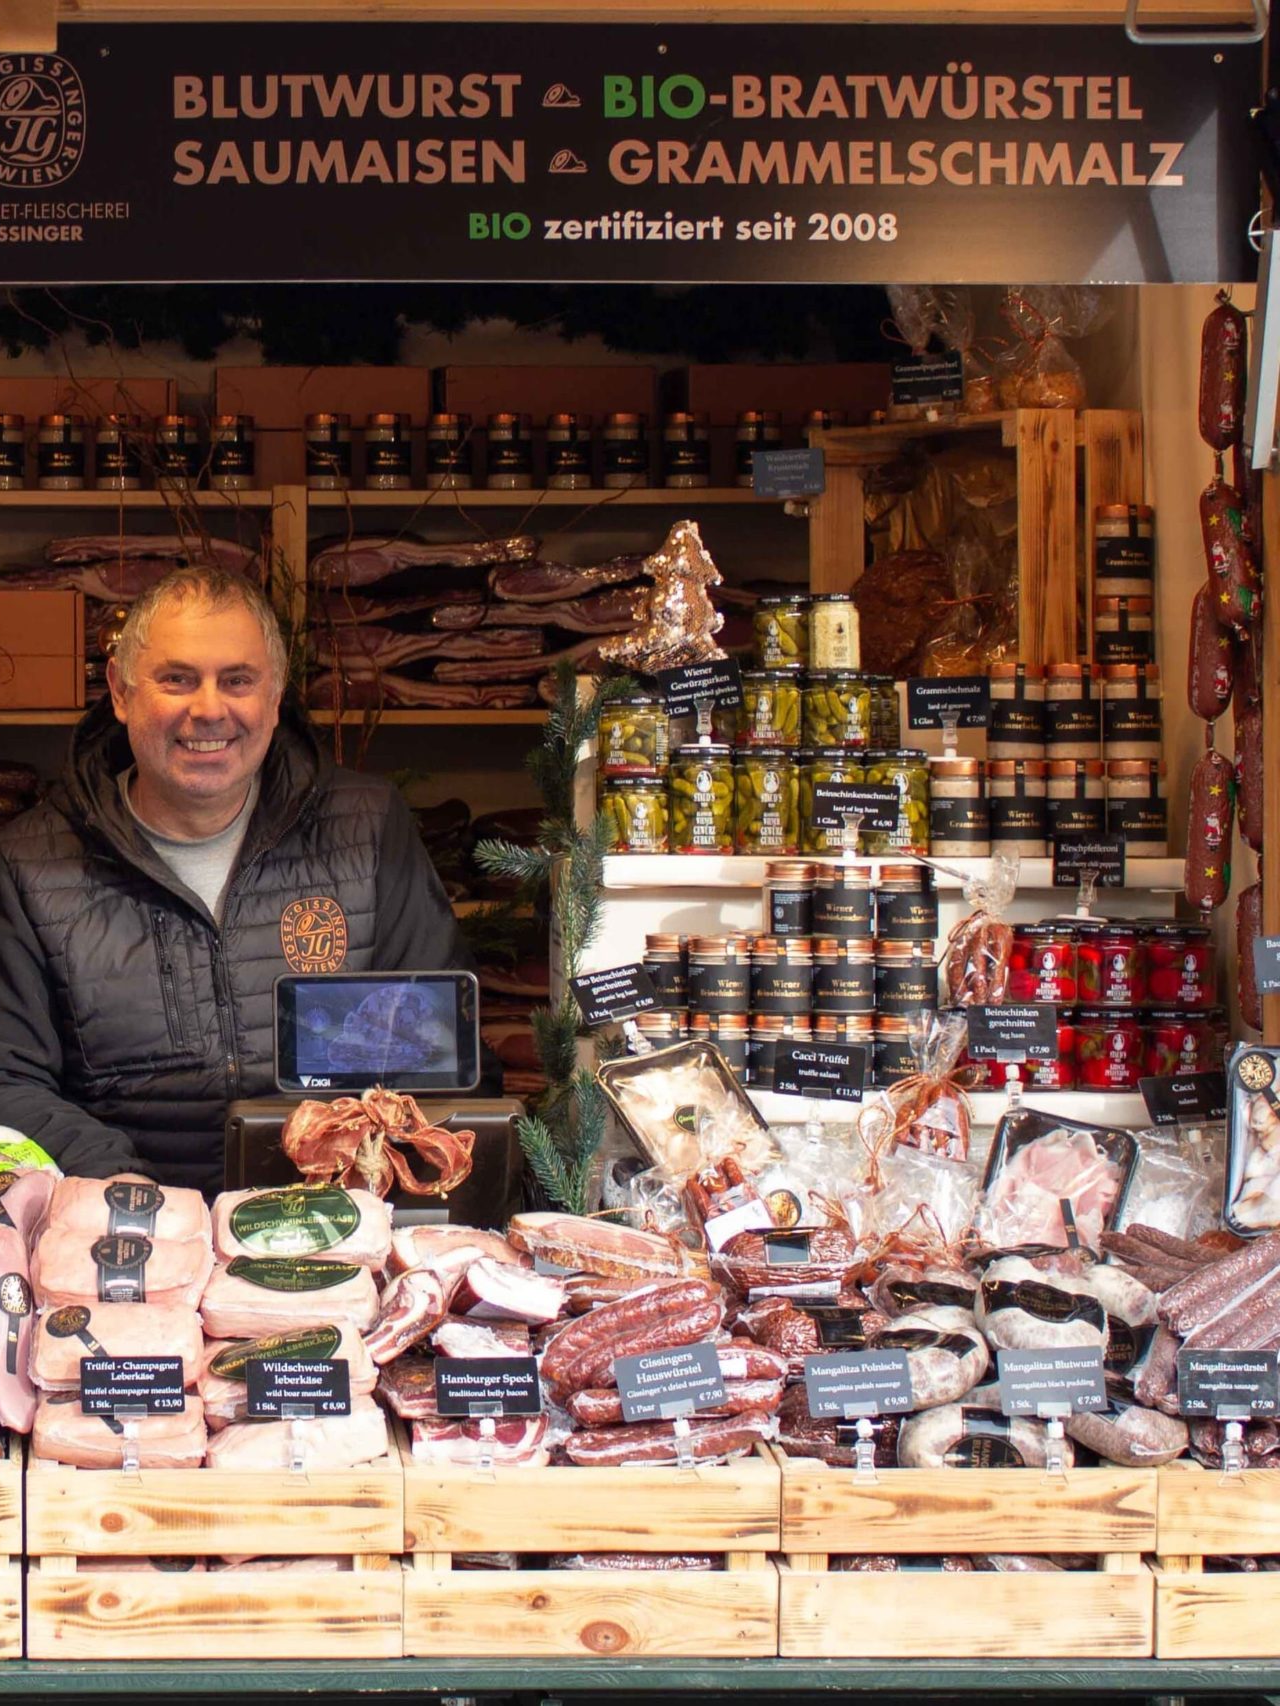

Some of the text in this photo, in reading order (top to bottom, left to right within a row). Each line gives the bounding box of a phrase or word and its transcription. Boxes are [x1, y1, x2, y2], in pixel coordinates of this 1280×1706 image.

[174, 61, 1142, 120] BLUTWURST BIO-BRATWÜRSTEL
[173, 138, 1185, 186] SAUMAISEN GRAMMELSCHMALZ
[469, 210, 898, 241] BIO zertifiziert seit 2008
[684, 667, 713, 677] Wiener
[671, 675, 730, 691] Gewürzgurken
[916, 686, 981, 696] Grammelschmalz
[816, 789, 898, 800] Beinschinkenschmalz
[294, 900, 345, 959] GISSINGER
[283, 915, 299, 961] JOSEF
[302, 957, 337, 973] WIEN
[985, 1008, 1039, 1017] Beinschinken
[989, 1018, 1036, 1029] geschnitten
[792, 1050, 849, 1065] Cacci Trüffel
[311, 1079, 331, 1087] DIGI
[639, 1352, 693, 1369] Gissingers
[1004, 1359, 1099, 1373] Mangalitza Blutwurst
[85, 1361, 179, 1373] Trüffel Champagner
[263, 1362, 333, 1373] Wildschwein-
[811, 1361, 904, 1377] Mangalitza Polnische
[1190, 1362, 1268, 1374] Mangalitzawürstel
[111, 1371, 155, 1381] Leberkäse
[636, 1363, 702, 1384] Hauswürstel
[274, 1375, 322, 1385] leberkäse
[441, 1374, 534, 1387] Hamburger Speck
[669, 1381, 688, 1392] dried
[689, 1376, 717, 1388] sausage
[107, 1387, 150, 1397] champagne
[150, 1386, 182, 1395] meatloaf
[266, 1389, 332, 1397] wild boar meatloaf
[449, 1389, 528, 1399] traditional belly bacon
[96, 1400, 112, 1408] Stk.
[161, 1399, 182, 1408] 13,90
[262, 1402, 277, 1410] Stk.
[329, 1402, 345, 1410] 8,90
